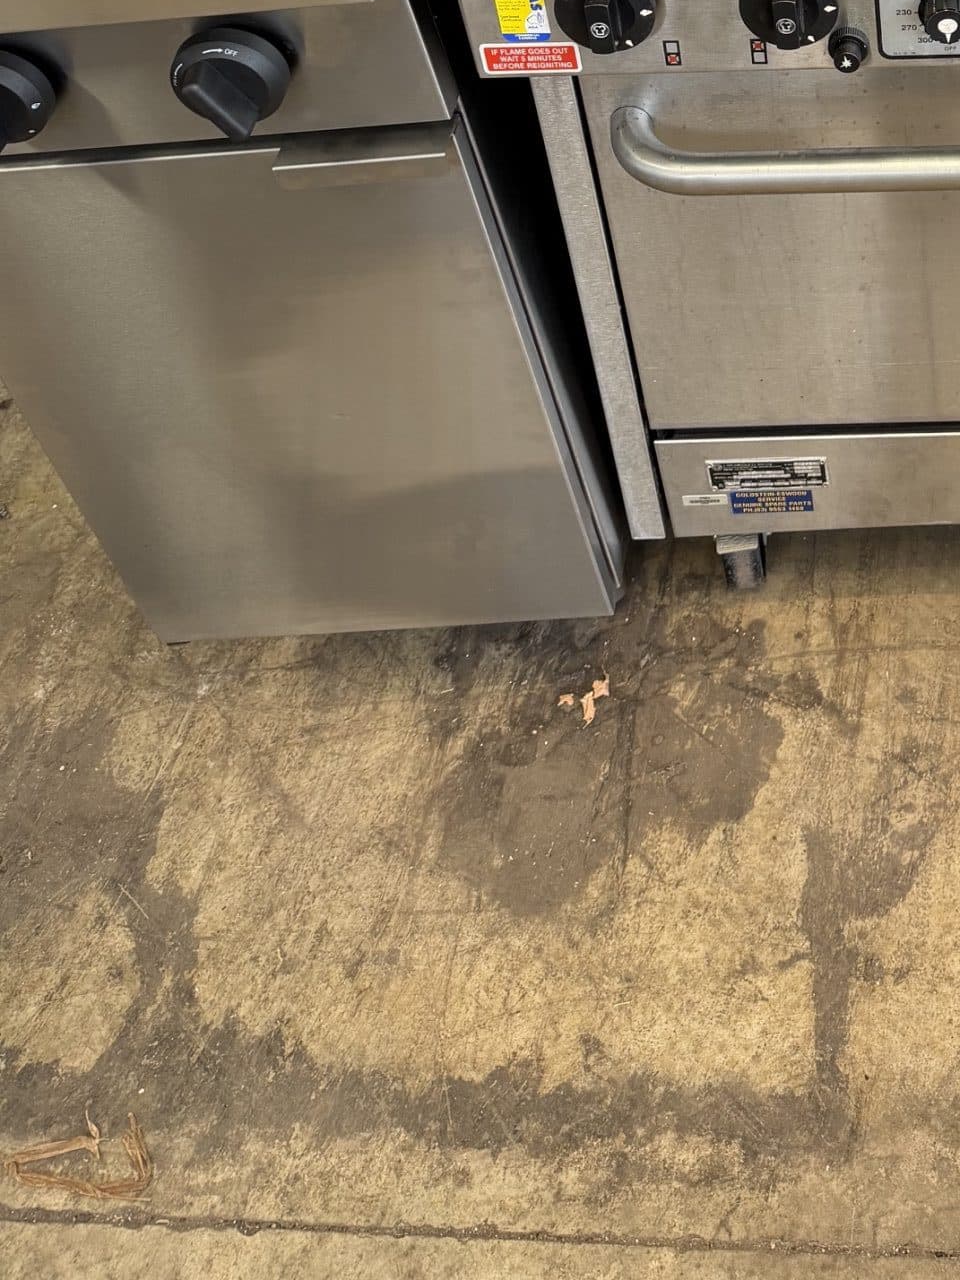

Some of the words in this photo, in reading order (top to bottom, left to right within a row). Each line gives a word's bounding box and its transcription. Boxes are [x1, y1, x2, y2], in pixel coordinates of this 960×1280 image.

[224, 48, 239, 57] OFF
[528, 47, 551, 55] GOES
[493, 62, 525, 70] BEFORE
